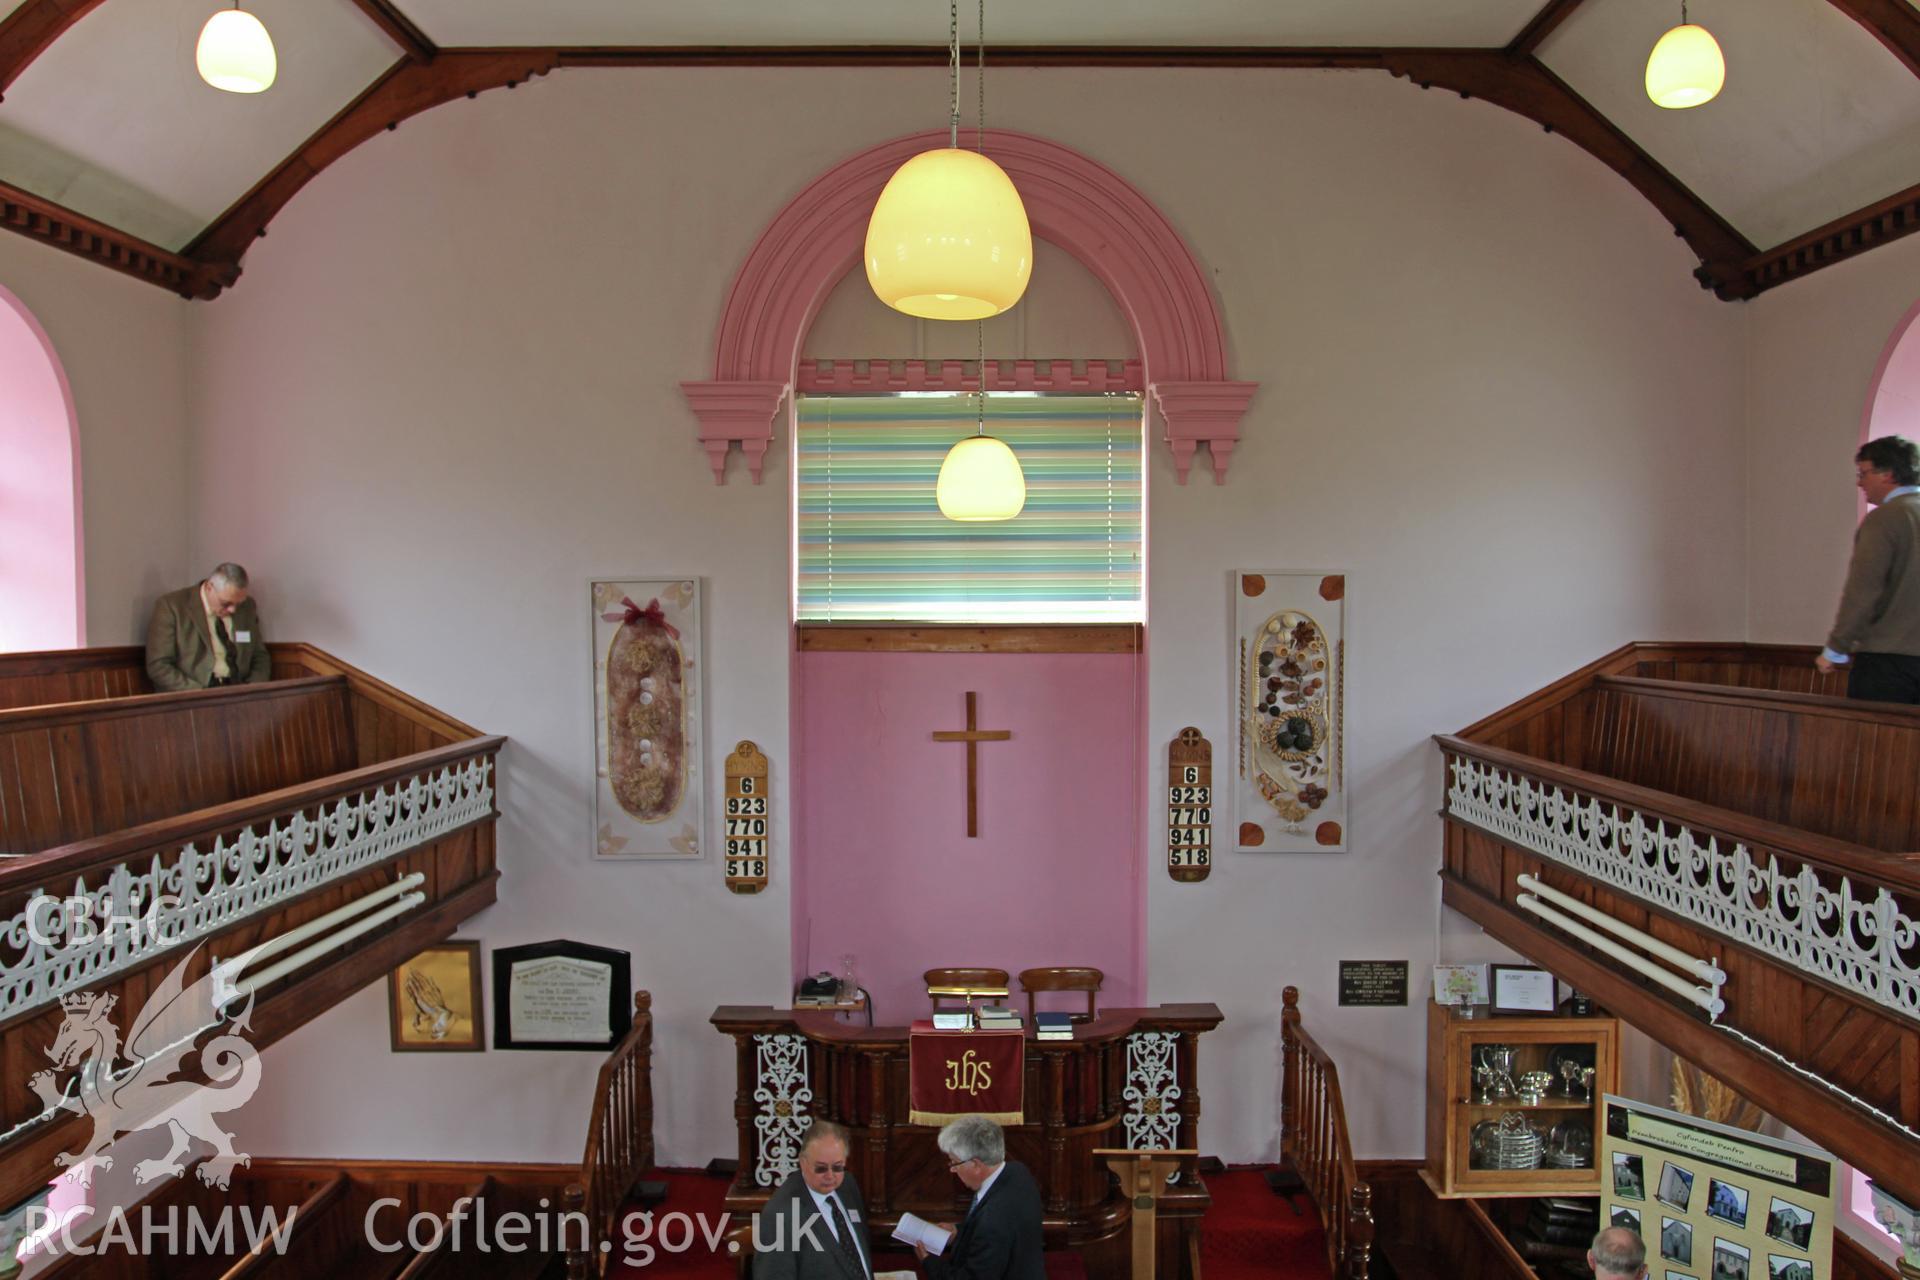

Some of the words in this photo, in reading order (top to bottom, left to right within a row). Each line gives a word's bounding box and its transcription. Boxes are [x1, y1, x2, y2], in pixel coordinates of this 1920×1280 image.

[1185, 767, 1197, 783] 6
[741, 777, 753, 794] 6
[1171, 787, 1209, 804] 923
[727, 798, 765, 815] 923
[1171, 808, 1210, 825] 770
[727, 819, 765, 835] 770
[1171, 829, 1206, 845] 941
[727, 839, 763, 856] 941
[1171, 848, 1208, 865] 518
[727, 860, 764, 877] 518
[1631, 1128, 1688, 1150] Pembrokeshire
[1690, 1145, 1752, 1168] Congregational
[1754, 1163, 1794, 1180] Churches
